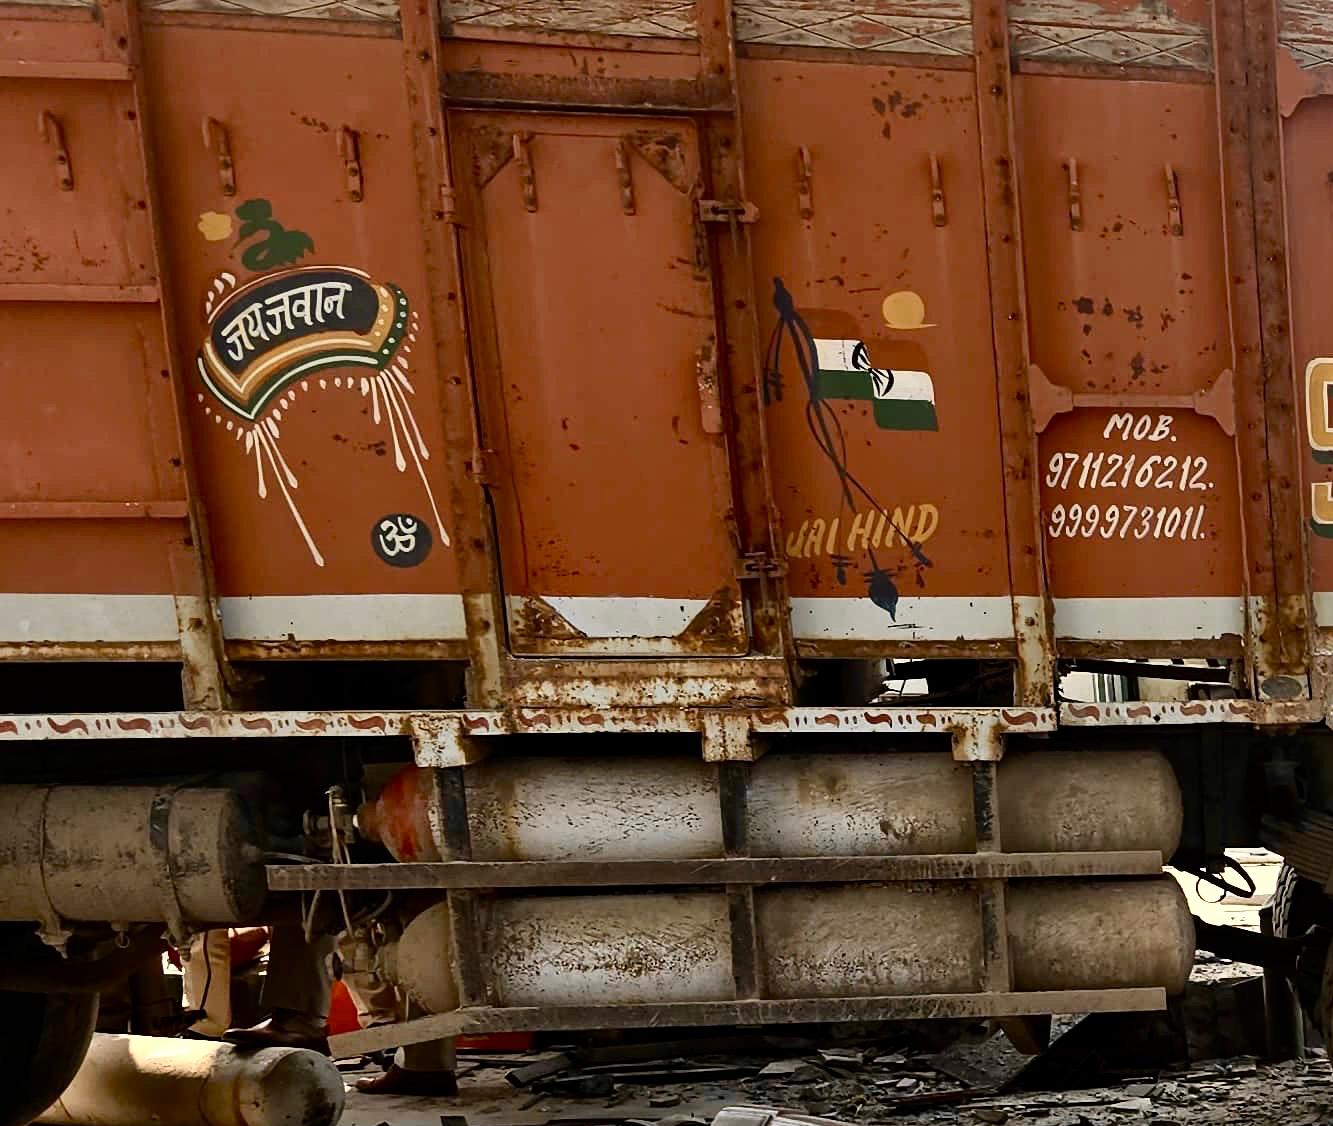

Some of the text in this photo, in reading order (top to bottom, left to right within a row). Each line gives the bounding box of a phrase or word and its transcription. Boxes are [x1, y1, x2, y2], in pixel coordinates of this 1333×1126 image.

[221, 281, 353, 362] जय जवान
[1103, 412, 1177, 442] MOB.
[1046, 452, 1214, 491] 9711216212.
[785, 503, 939, 558] JAI HIND
